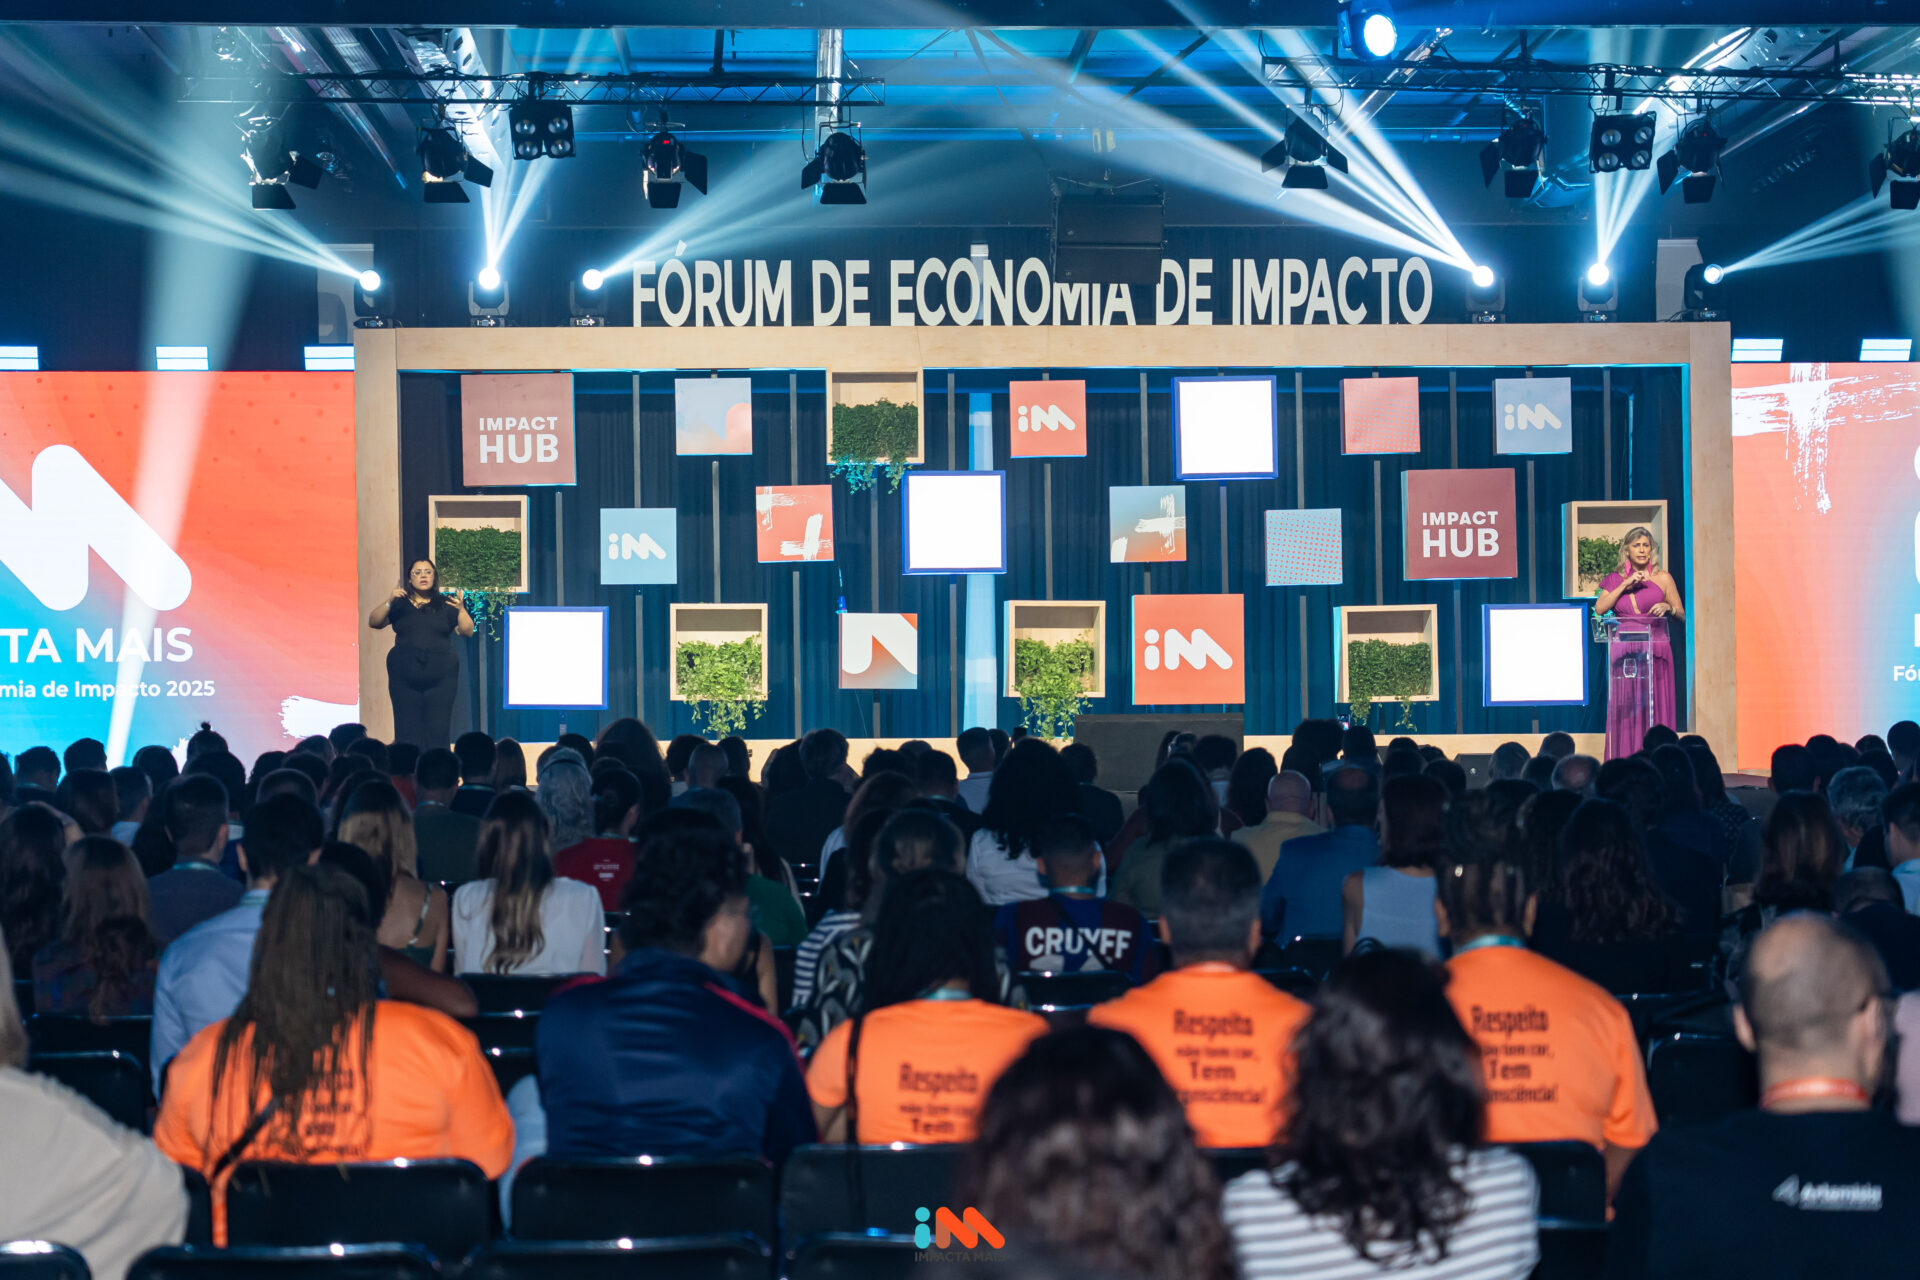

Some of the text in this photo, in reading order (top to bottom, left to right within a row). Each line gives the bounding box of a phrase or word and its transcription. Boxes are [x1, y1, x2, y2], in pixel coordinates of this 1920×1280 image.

[633, 240, 1433, 327] FÓRUM DE ECONOMIA DE IMPACTO
[479, 416, 559, 431] IMPACT
[479, 433, 560, 464] HUB
[1422, 511, 1499, 526] IMPACT
[1422, 527, 1500, 558] HUB
[76, 627, 194, 663] MAIS
[42, 681, 69, 698] de
[75, 681, 161, 701] Impacto
[166, 680, 215, 697] 2025
[1025, 926, 1132, 959] CRUYFF
